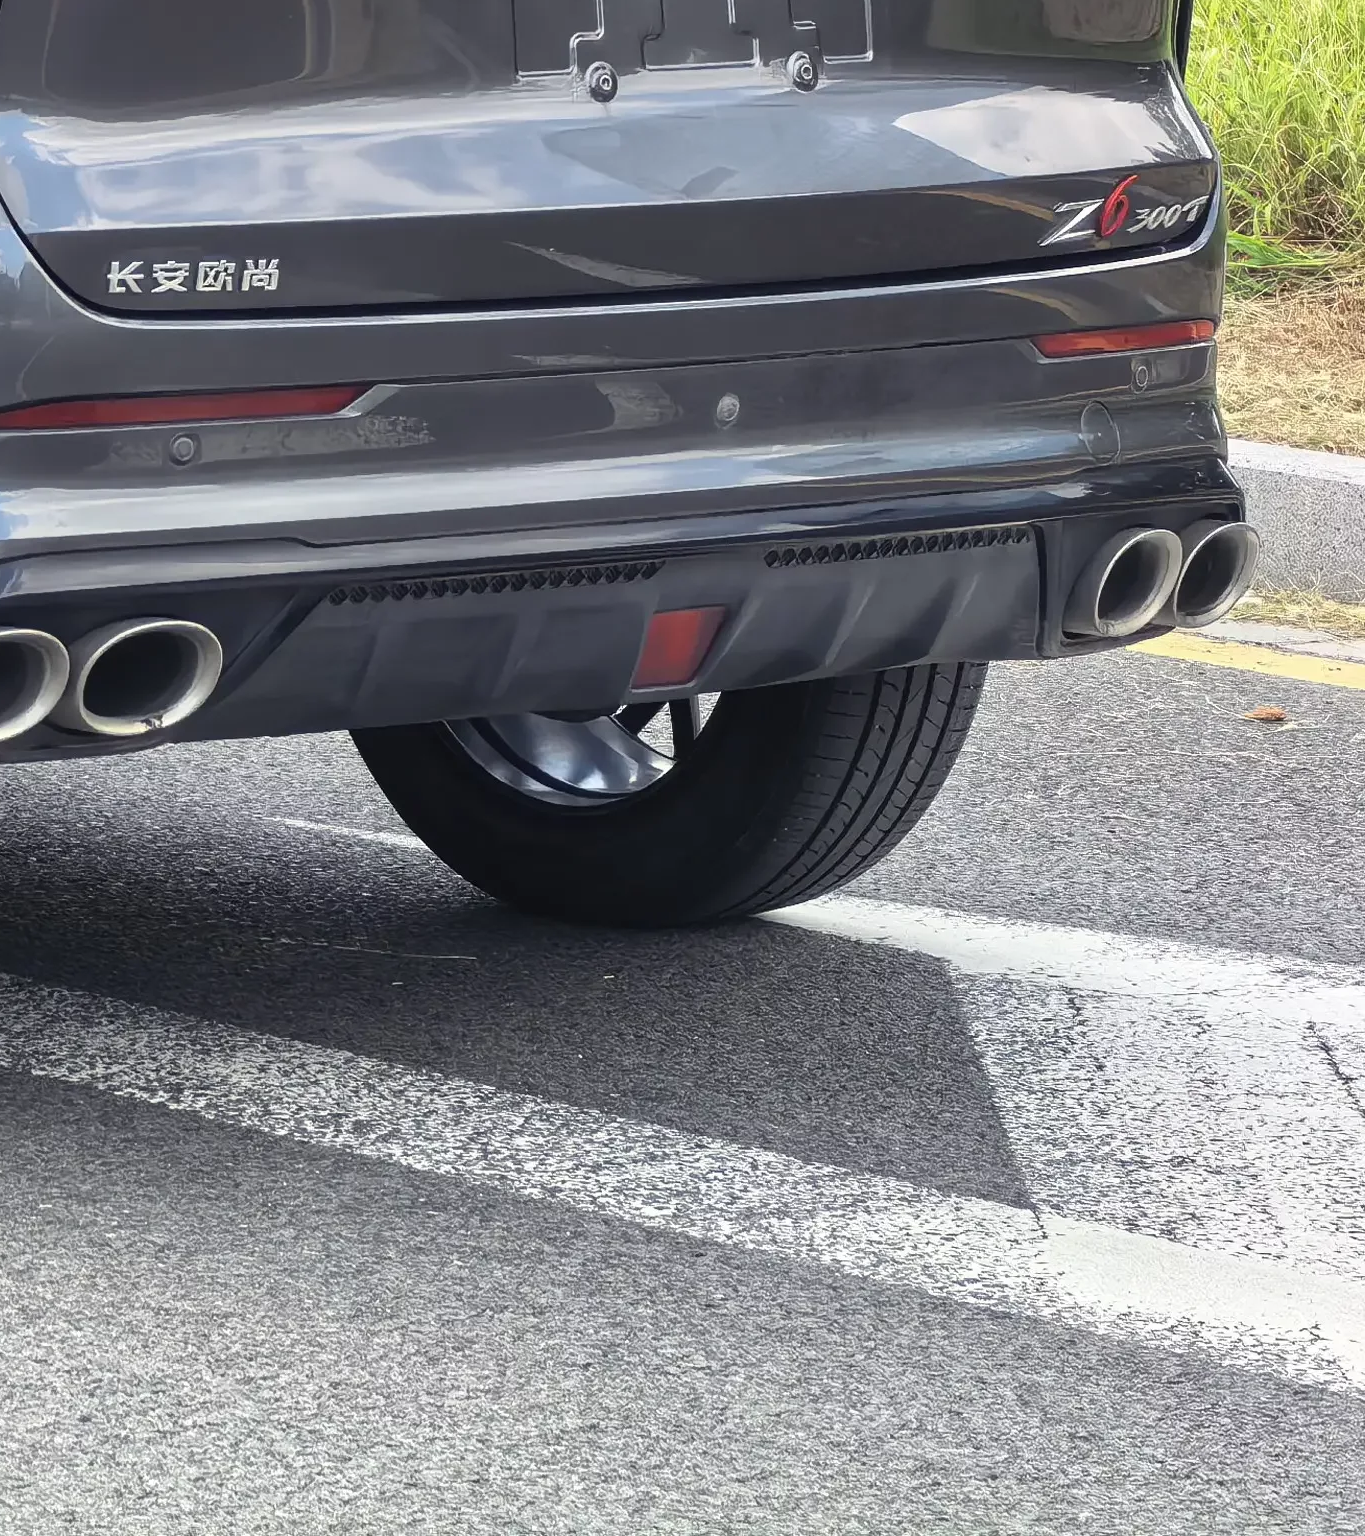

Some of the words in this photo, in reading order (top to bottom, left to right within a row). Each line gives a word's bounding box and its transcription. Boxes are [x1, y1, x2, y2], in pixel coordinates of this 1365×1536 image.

[1037, 174, 1139, 247] Z6
[1126, 195, 1210, 233] 300T
[106, 258, 281, 294] 长安欧尚
